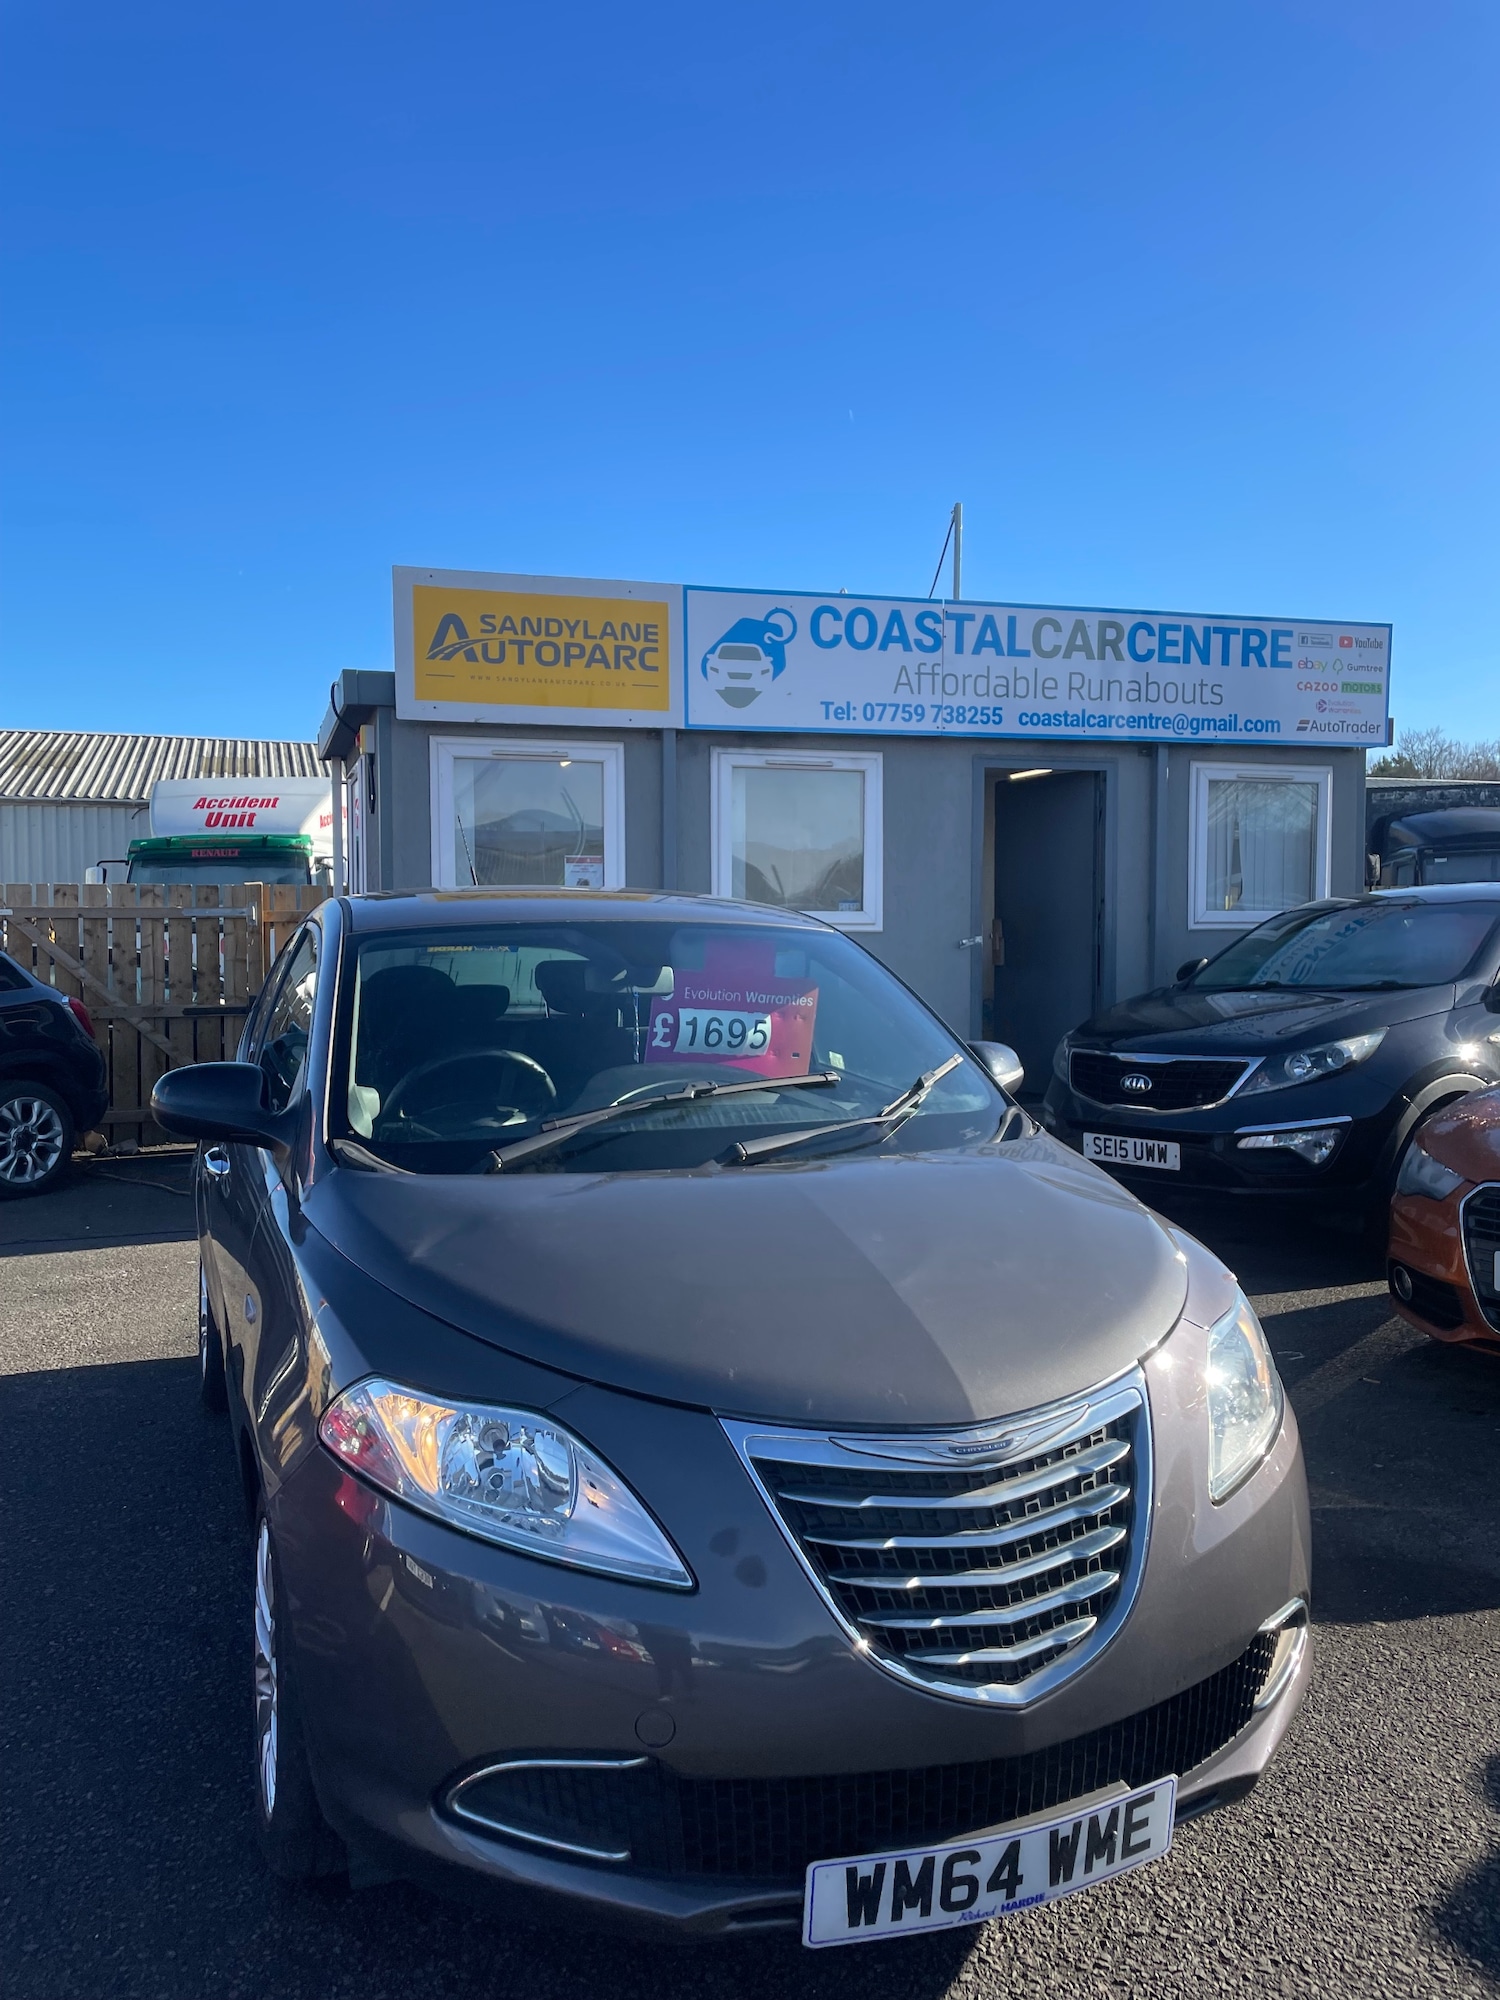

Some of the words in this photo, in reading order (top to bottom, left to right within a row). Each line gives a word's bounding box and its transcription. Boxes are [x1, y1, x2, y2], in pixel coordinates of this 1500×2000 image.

[479, 613, 659, 644] SANDYLANE
[1354, 637, 1384, 650] YouTube
[1346, 663, 1384, 673] Gumtree
[893, 662, 1058, 704] Affordable
[1068, 671, 1224, 706] Runabouts
[1296, 681, 1339, 693] CAZOO
[819, 700, 857, 721] Tel:
[862, 702, 926, 723] 07759
[930, 705, 1003, 726] 738255
[1018, 709, 1281, 736] coastalcarcentre@gmail.com
[1309, 720, 1381, 734] AutoTrader
[193, 796, 280, 810] Accident
[204, 811, 257, 828] Unit
[191, 848, 240, 858] RENAULT
[684, 986, 741, 1003] Evolution
[745, 990, 814, 1008] Warranties
[1124, 1077, 1146, 1090] KIA
[1093, 1136, 1129, 1159] SE15
[1133, 1140, 1168, 1164] UWW
[845, 1839, 1024, 1929] WM64
[1048, 1791, 1156, 1888] WME
[1000, 1891, 1046, 1914] HARDIE
